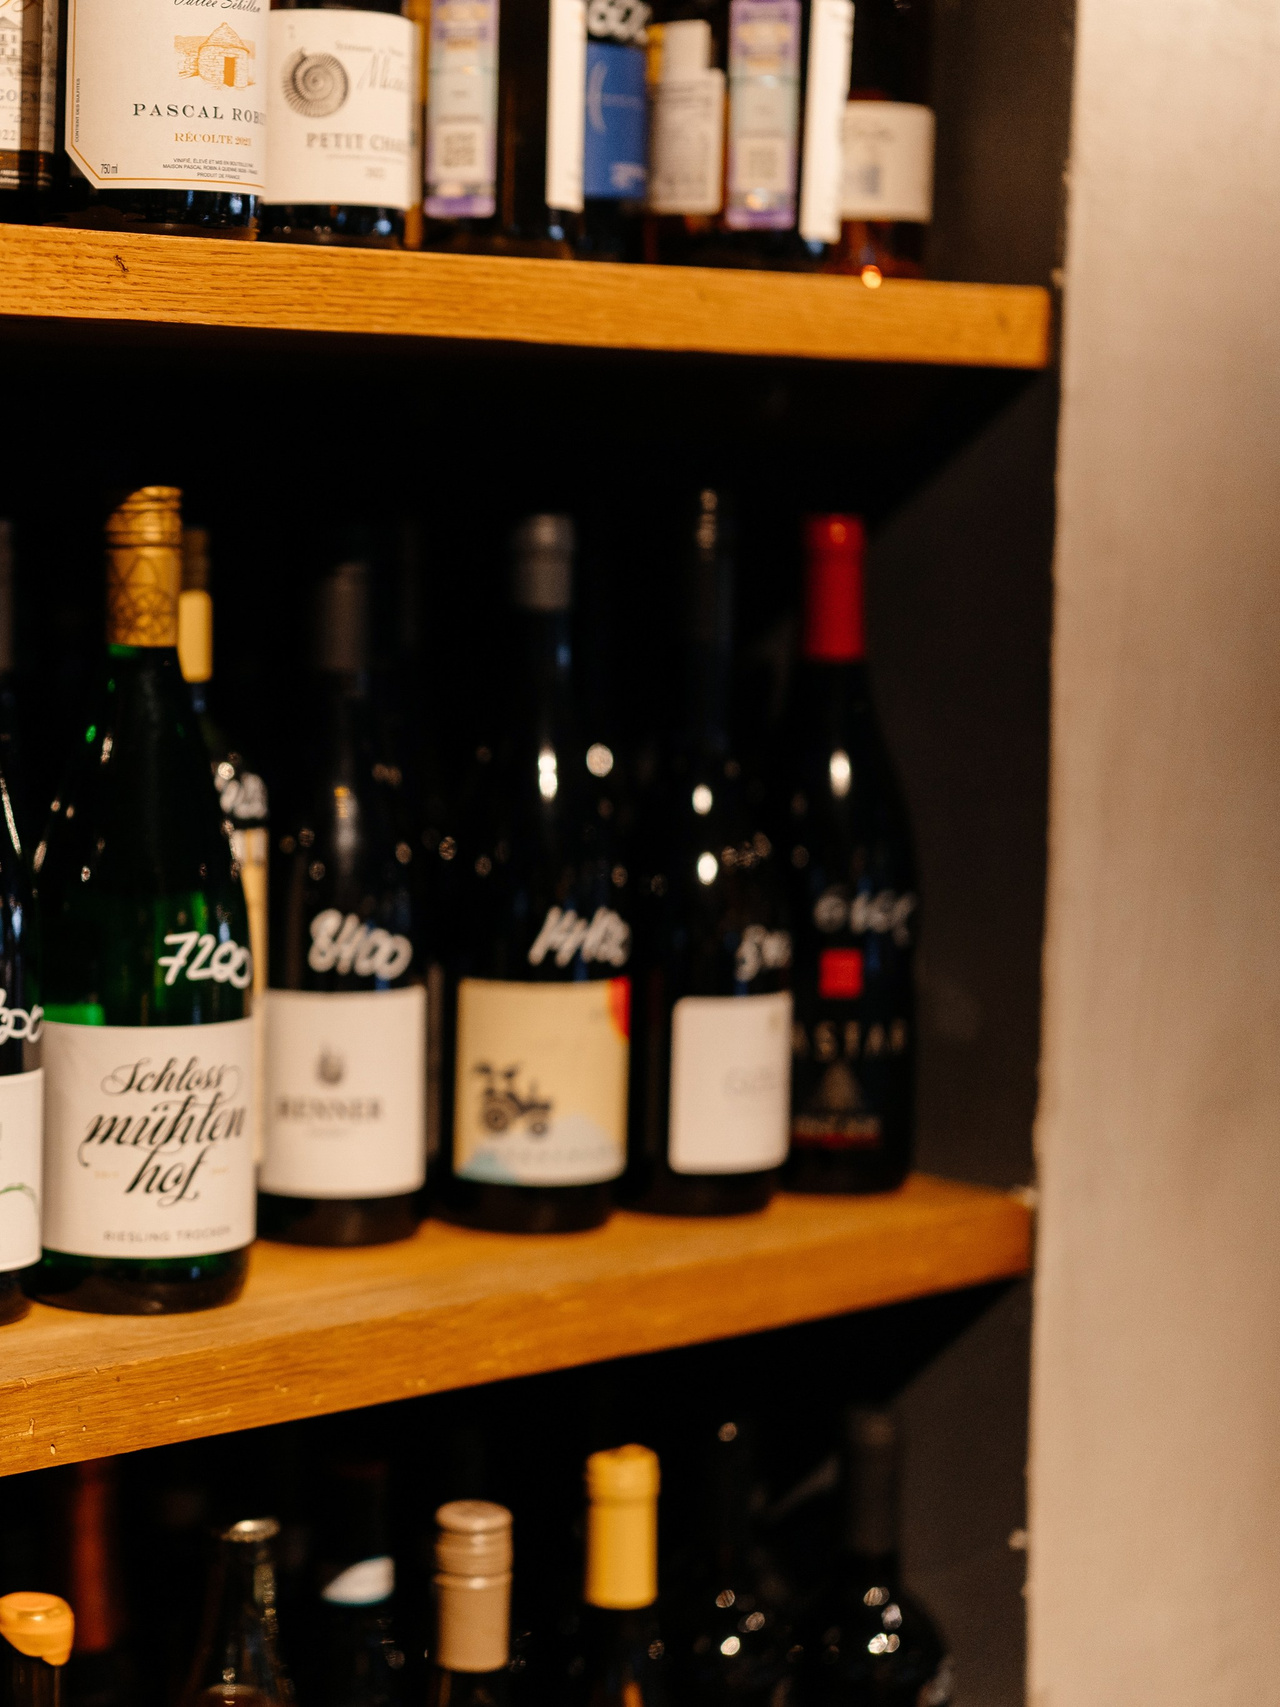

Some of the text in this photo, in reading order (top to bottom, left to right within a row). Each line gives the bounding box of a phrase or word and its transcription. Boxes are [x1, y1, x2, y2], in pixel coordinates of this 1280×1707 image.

[133, 103, 266, 126] PASCAL ROB
[174, 131, 233, 145] RÉCOLTE
[101, 163, 118, 174] 750 ml
[157, 930, 253, 990] 7200
[101, 1055, 240, 1097] Schloss
[80, 1092, 247, 1150] mühlen
[125, 1145, 212, 1208] hof
